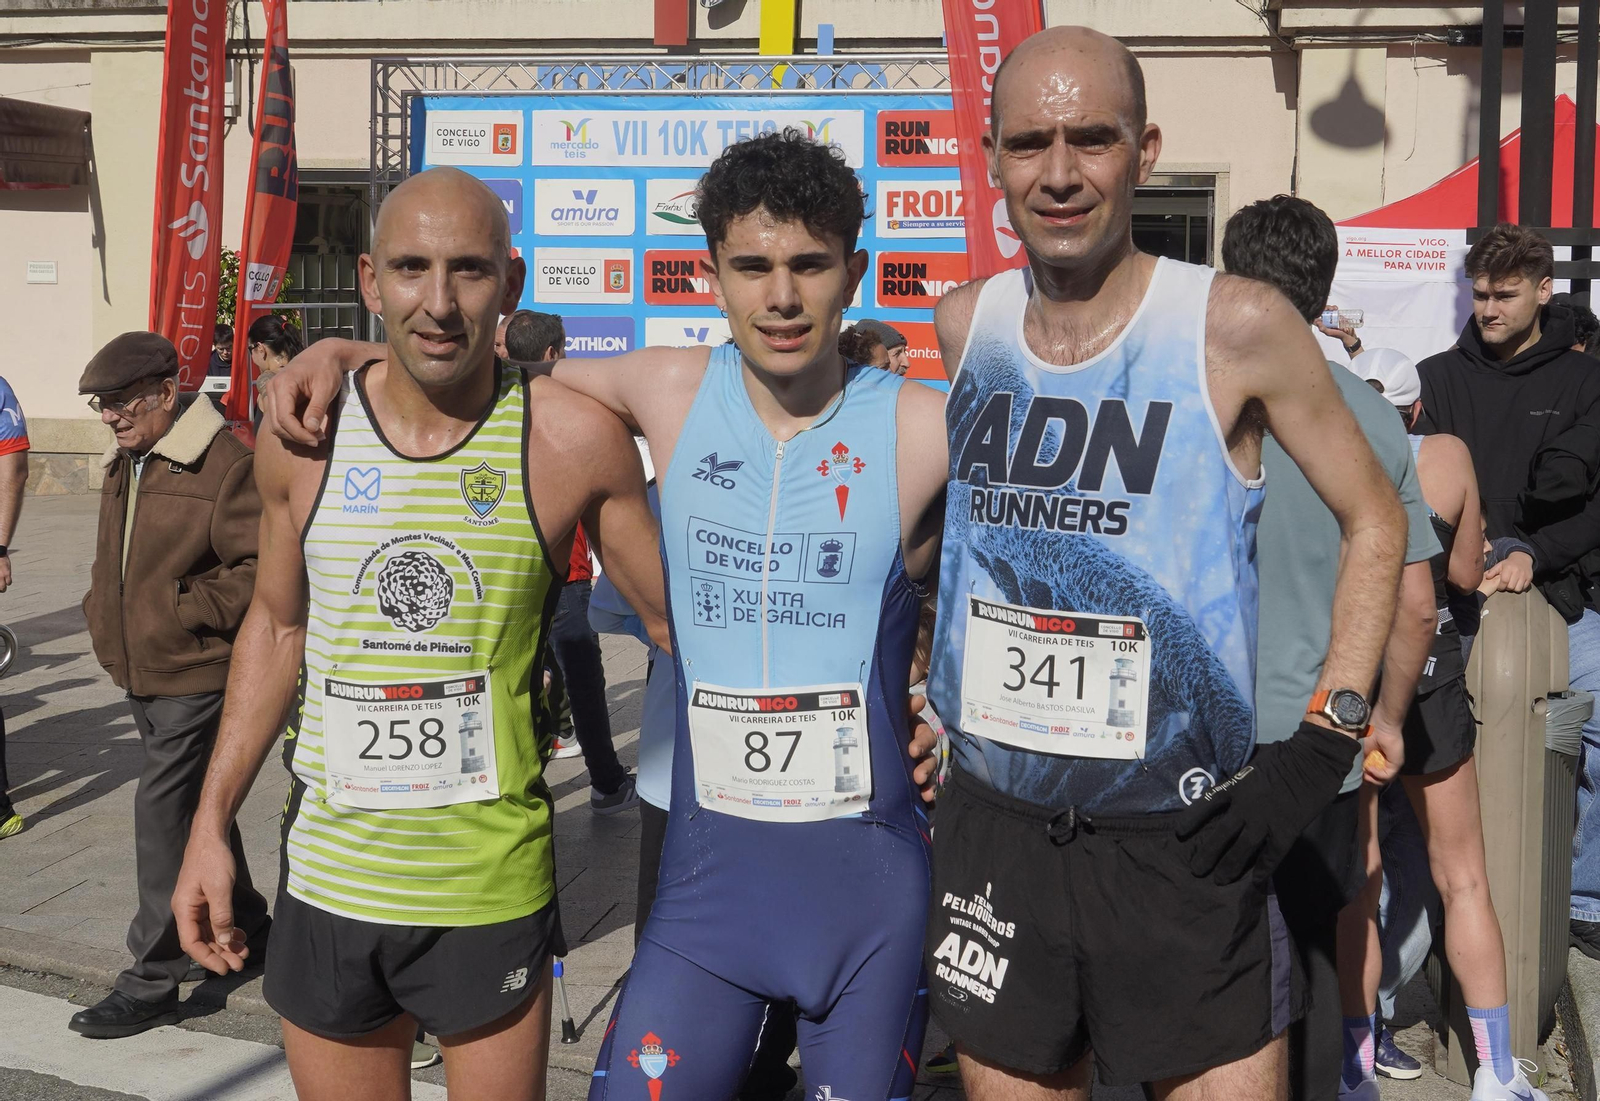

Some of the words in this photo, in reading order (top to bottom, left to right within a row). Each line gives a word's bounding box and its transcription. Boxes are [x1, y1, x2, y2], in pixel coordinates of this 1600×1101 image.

[436, 128, 486, 138] CONCELLO
[886, 121, 930, 137] RUN
[442, 138, 454, 147] DE
[458, 139, 480, 147] VIGO
[550, 138, 599, 150] mercado
[612, 120, 648, 156] VII
[658, 119, 708, 156] 10K
[564, 149, 586, 158] teis
[551, 207, 620, 221] amura
[655, 202, 683, 212] Frutas
[1357, 249, 1402, 258] MELLOR
[1406, 250, 1446, 259] CIDADE
[542, 266, 596, 275] CONCELLO
[652, 261, 694, 276] RUN
[883, 263, 926, 278] RUN
[1384, 262, 1412, 270] PARA
[1416, 262, 1446, 270] VIVIR
[549, 277, 562, 286] DE
[564, 277, 590, 286] VIGO
[652, 278, 710, 293] RUNVI
[956, 392, 1173, 494] ADN
[692, 468, 736, 490] ZICO
[342, 504, 378, 514] MARÍN
[969, 488, 1131, 536] RUNNERS
[696, 529, 793, 556] CONCELLO
[353, 549, 381, 595] Comunidade
[380, 542, 390, 551] de
[390, 534, 422, 546] Montes
[461, 553, 476, 571] Man
[706, 550, 729, 568] DE
[732, 556, 780, 573] VIGO
[732, 588, 804, 608] XUNTA
[733, 607, 756, 623] DE
[762, 609, 846, 629] GALICIA
[1008, 629, 1018, 638] VII
[1019, 633, 1058, 646] CARREIRA
[1060, 638, 1073, 646] DE
[1075, 639, 1094, 648] TEIS
[362, 639, 412, 652] Santomé
[415, 640, 428, 652] de
[430, 641, 471, 654] Piñeiro
[1110, 640, 1138, 653] 10K
[1002, 646, 1086, 700] 341
[356, 704, 366, 712] VII
[368, 703, 410, 712] CARREIRA
[412, 703, 423, 711] DE
[425, 702, 442, 710] TEIS
[456, 695, 480, 707] 10K
[1013, 698, 1036, 709] Alberto
[1036, 703, 1064, 712] BASTOS
[1066, 705, 1096, 714] DASILVA
[799, 714, 817, 722] TEIS
[831, 709, 856, 721] 10K
[989, 714, 1018, 728] Santander
[357, 718, 447, 760] 258
[744, 730, 802, 773] 87
[351, 784, 379, 793] Santander
[732, 776, 748, 784] Mario
[749, 778, 787, 786] RODRIGUEZ
[942, 892, 1016, 938] PELUQUEROS
[950, 916, 972, 929] VINTAGE
[933, 932, 1009, 990] ADN
[935, 963, 997, 1004] RUNNERS
